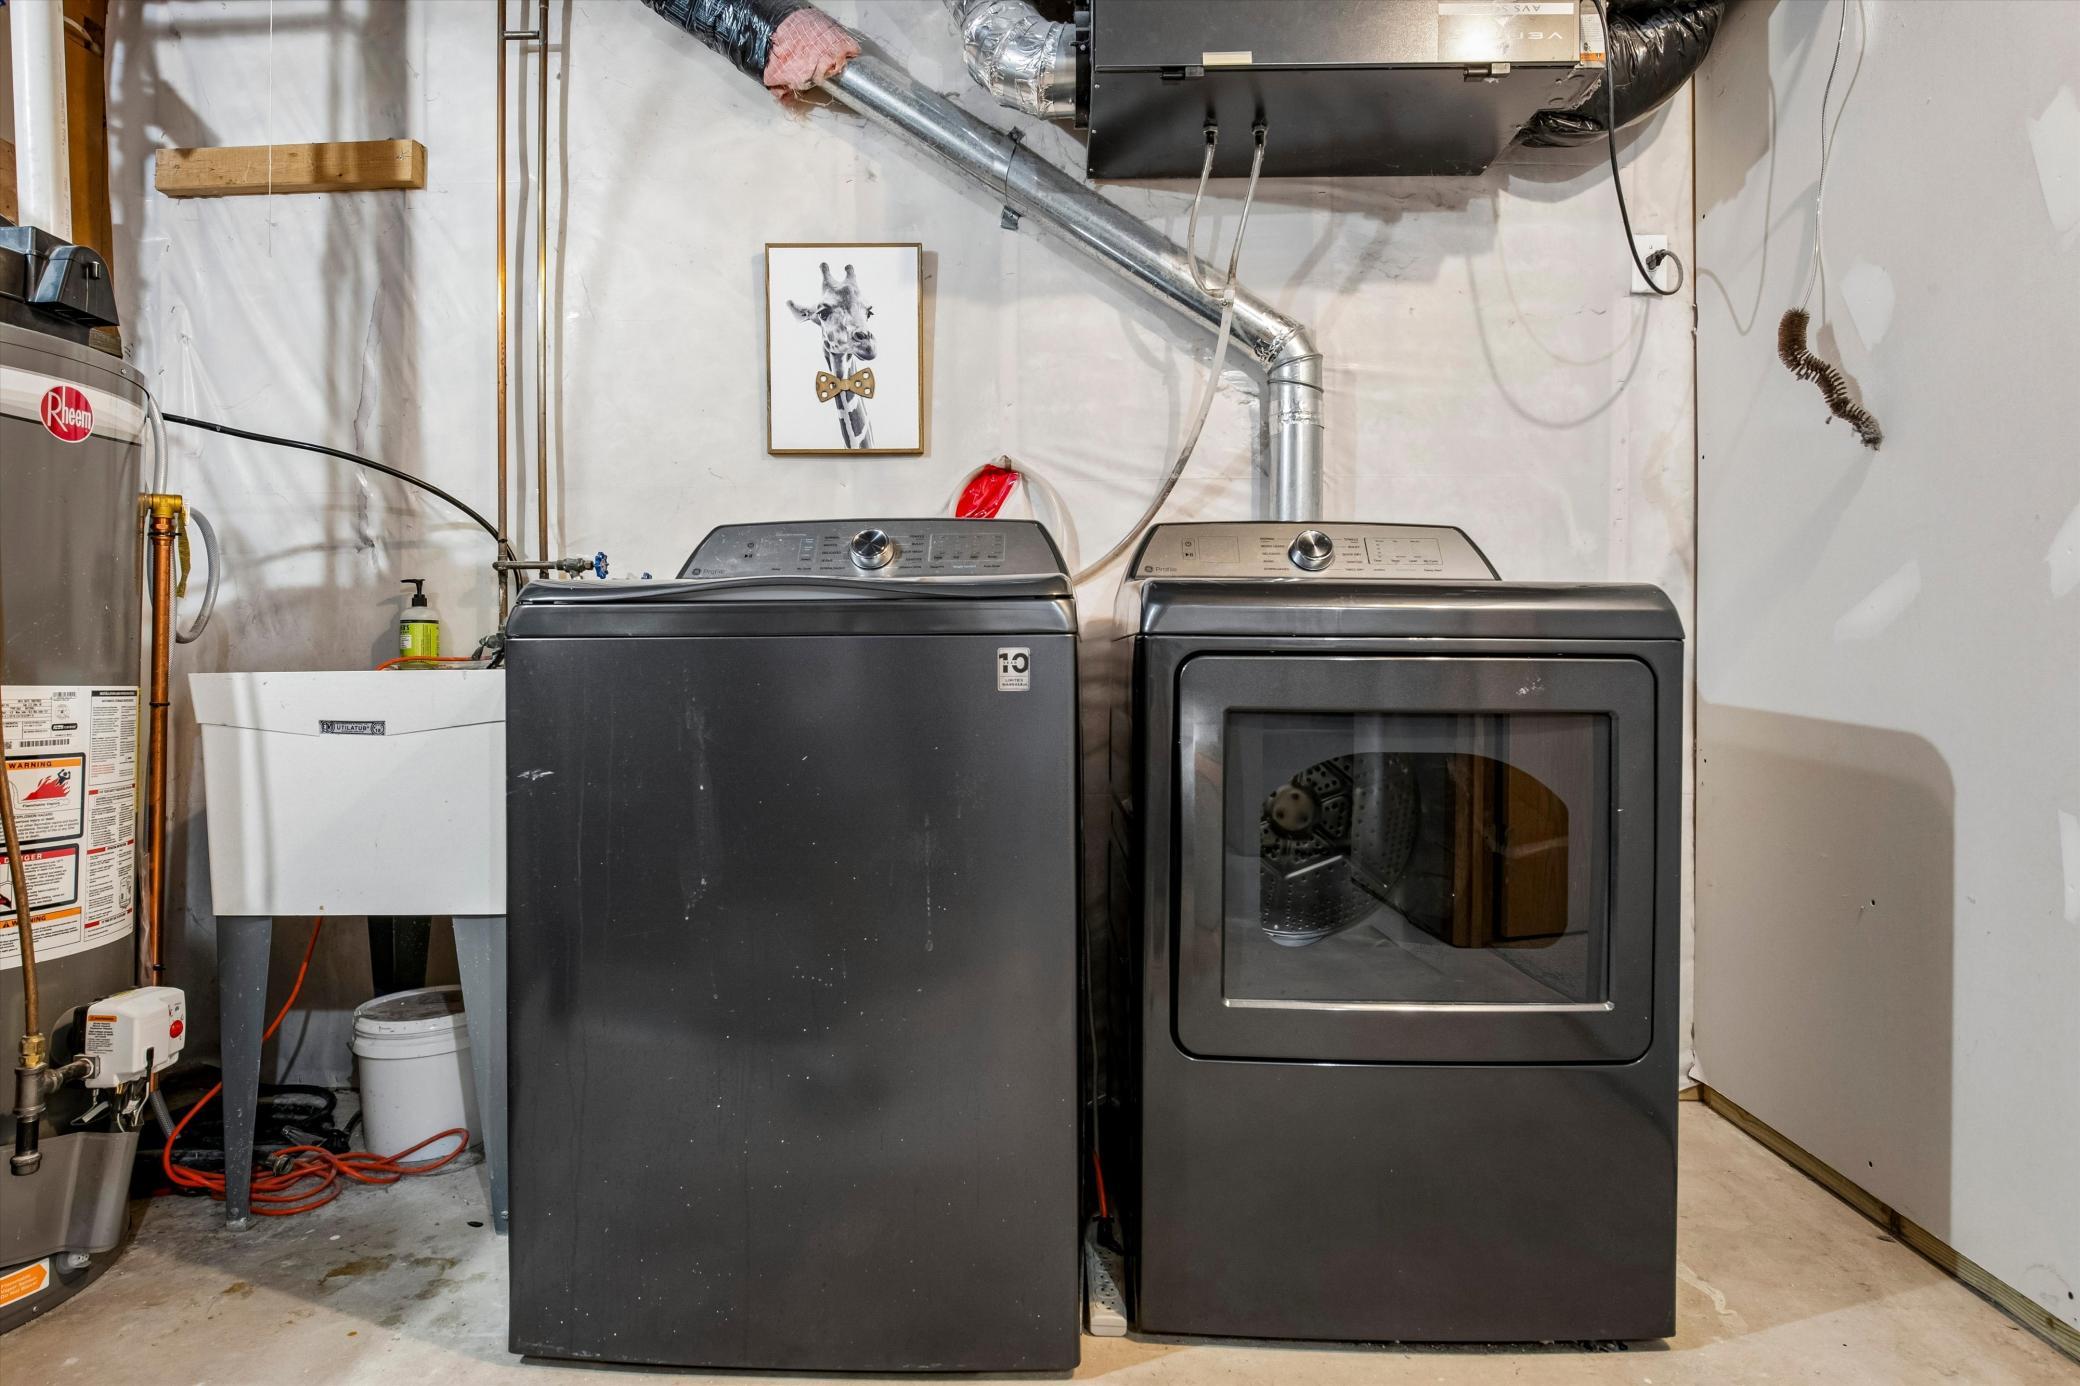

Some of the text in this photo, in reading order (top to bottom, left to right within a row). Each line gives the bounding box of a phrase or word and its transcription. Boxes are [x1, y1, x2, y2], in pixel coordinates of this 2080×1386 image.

[1514, 4, 1541, 12] AVS
[47, 385, 92, 432] Rheem
[999, 653, 1028, 673] 10
[8, 761, 52, 769] WARNING
[4, 853, 43, 864] DGER
[12, 915, 46, 925] WNING
